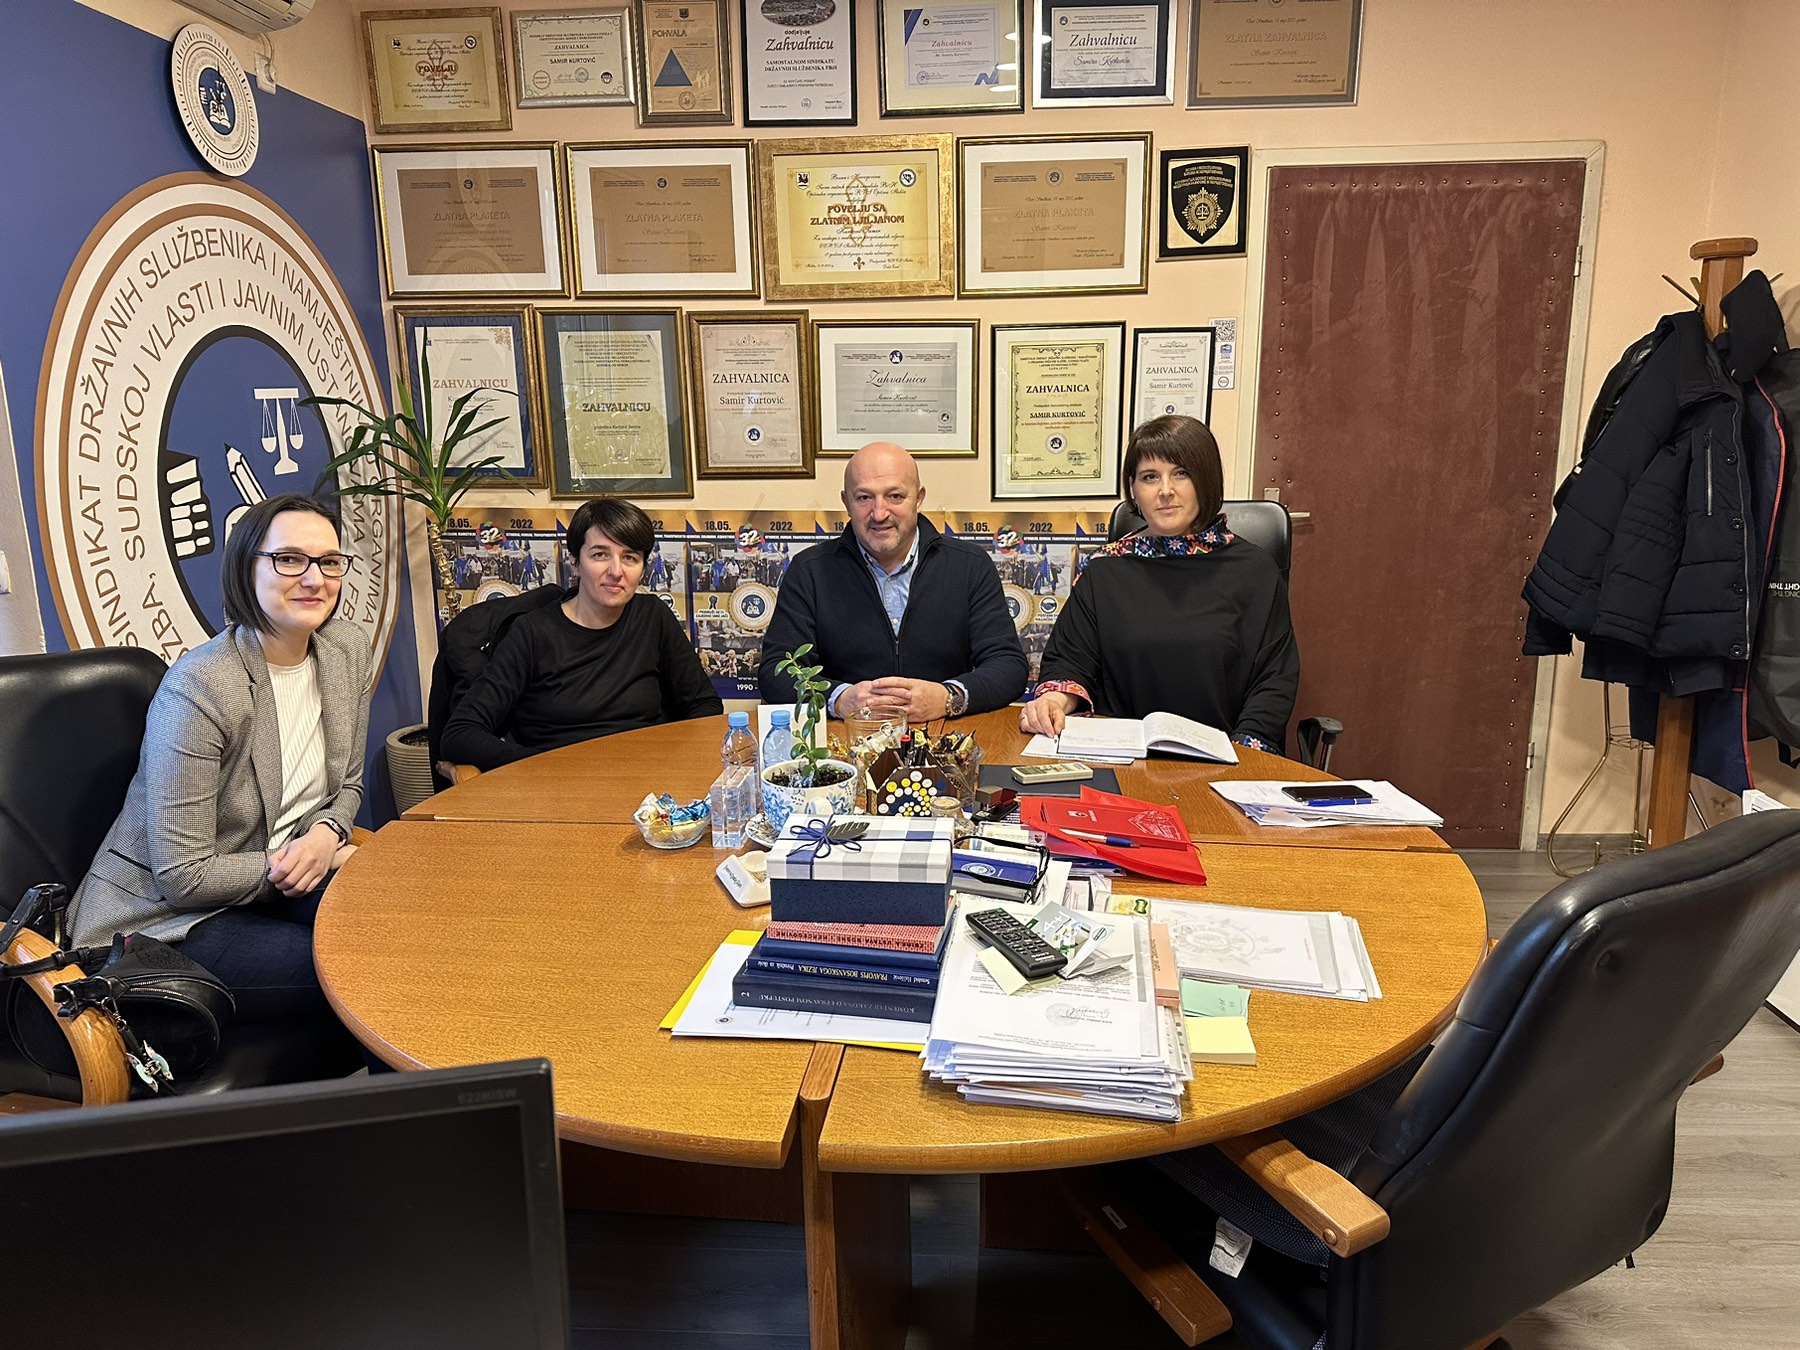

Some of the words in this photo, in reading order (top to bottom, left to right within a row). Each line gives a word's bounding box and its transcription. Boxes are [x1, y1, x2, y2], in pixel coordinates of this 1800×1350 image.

[652, 30, 688, 38] POHVALA
[1265, 32, 1327, 42] ZAHVALNICA
[765, 36, 834, 52] Zahvalnicu
[932, 40, 973, 48] Zahvalnicu
[1069, 33, 1138, 47] Zahvalnicu
[418, 65, 457, 73] POVELJU
[828, 204, 870, 214] POVELJU
[872, 204, 887, 212] SA
[1015, 208, 1051, 219] ZLATNA
[1052, 208, 1095, 218] PLAKETA
[434, 212, 468, 222] ZLATNA
[470, 211, 511, 220] PLAKETA
[626, 214, 661, 223] ZLATNA
[662, 214, 704, 223] PLAKETA
[810, 216, 851, 226] ZLATNIM
[853, 215, 905, 225] LJILJANOM
[139, 226, 266, 289] SLUŽBENIKA
[272, 252, 276, 276] I
[281, 261, 370, 426] NAMJEŠTNI
[79, 277, 143, 462] DRŽAVNIH
[1146, 367, 1198, 375] ZAHVALNICA
[433, 379, 508, 388] ZAHVALNICU
[712, 373, 790, 384] ZAHVALNICA
[866, 369, 928, 388] Zahvalnica
[1026, 385, 1090, 394] ZAHVALNICA
[720, 396, 744, 405] Samir
[747, 396, 785, 405] Kurtović
[582, 403, 651, 412] ZAHVALNICU
[1052, 410, 1086, 418] KURTOVIĆ
[116, 363, 150, 561] SUDSKOJ
[140, 281, 214, 362] VLASTI
[219, 278, 226, 307] I
[233, 279, 304, 345] JAVNIM
[340, 581, 360, 621] FB
[510, 519, 533, 529] 2022
[654, 521, 664, 530] 22
[704, 521, 732, 531] 18.05.
[770, 522, 793, 531] 2022
[963, 523, 991, 532] 18.05.
[1029, 523, 1053, 533] 2022
[481, 528, 499, 544] 32
[740, 530, 758, 546] 32
[998, 532, 1018, 548] 32
[79, 475, 138, 647] SINDIKAT
[776, 931, 828, 940] HERCEGOVINE
[837, 935, 862, 943] BOSNE
[866, 938, 892, 946] USTAVA
[798, 965, 818, 974] JEZIKA
[820, 967, 858, 978] BOSANSKOGA
[860, 971, 888, 981] PRAVOPIS
[758, 995, 795, 1003] POSTUPKU
